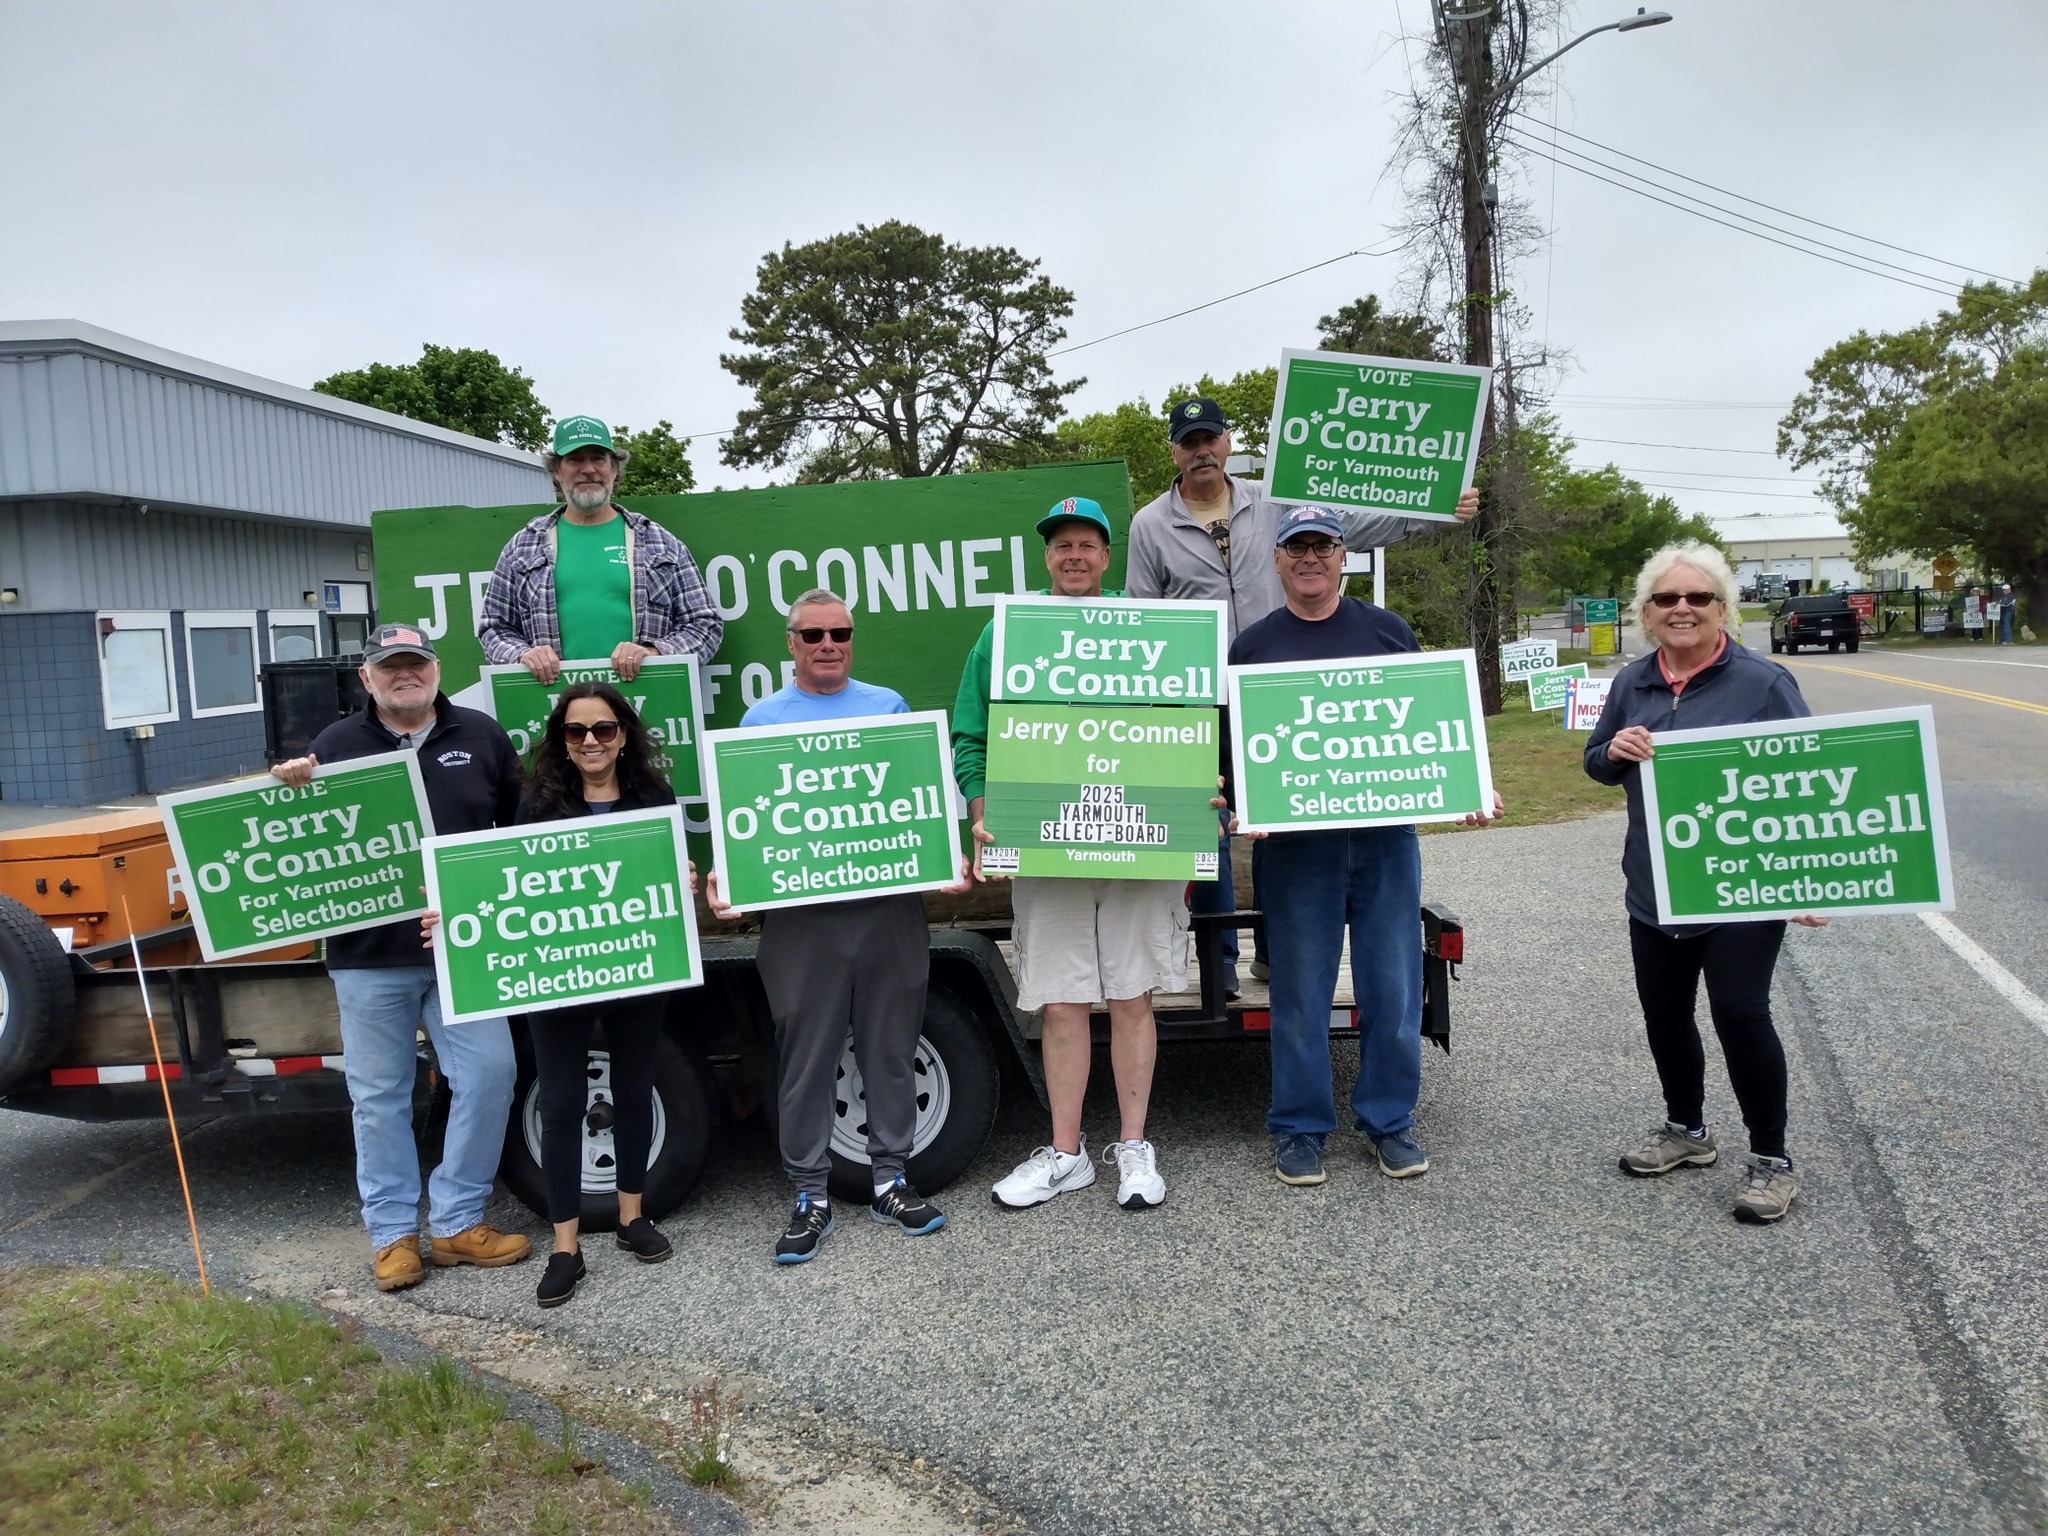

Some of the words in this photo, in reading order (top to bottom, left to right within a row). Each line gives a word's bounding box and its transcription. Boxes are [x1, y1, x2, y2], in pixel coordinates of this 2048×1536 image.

[1358, 368, 1412, 386] VOTE
[1328, 388, 1431, 432] Jerry
[1284, 410, 1465, 461] O'Connell
[1305, 454, 1337, 471] For
[1343, 458, 1439, 482] Yarmouth
[1062, 498, 1076, 514] B
[1307, 476, 1432, 506] Selectboard
[705, 535, 1041, 621] O'CONNEL
[1081, 610, 1142, 625] VOTE
[1054, 631, 1167, 670] Jerry
[1507, 657, 1554, 672] ARGO
[1526, 647, 1547, 658] LIZ
[1006, 656, 1212, 698] O'Connell
[1318, 669, 1383, 687] VOTE
[1294, 696, 1414, 730] Jerry
[797, 733, 861, 752] VOTE
[1000, 717, 1068, 744] Jerry
[1078, 719, 1211, 744] O'Connell
[1248, 720, 1470, 764] O'Connell
[1743, 734, 1820, 758] VOTE
[437, 751, 472, 763] BOSTON
[1086, 754, 1120, 773] for
[774, 761, 890, 797] Jerry
[1281, 771, 1320, 787] For
[1326, 762, 1447, 785] Yarmouth
[1717, 766, 1858, 806] Jerry
[259, 780, 328, 806] VOTE
[1082, 786, 1123, 803] 2025
[1290, 785, 1444, 816] Selectboard
[242, 804, 361, 848] Jerry
[728, 786, 942, 840] O'Connell
[1062, 804, 1144, 823] YARMOUTH
[1665, 794, 1926, 849] O'Connell
[521, 832, 590, 855] VOTE
[762, 846, 801, 864] For
[808, 830, 922, 858] Yarmouth
[1042, 823, 1166, 843] SELECT-BOARD
[198, 821, 422, 893] O'Connell
[1066, 849, 1136, 863] Yarmouth
[1196, 853, 1217, 862] 2025
[1705, 855, 1749, 875] For
[1757, 844, 1898, 871] Yarmouth
[239, 892, 279, 912] For
[285, 864, 404, 901] Yarmouth
[498, 860, 621, 900] Jerry
[772, 854, 919, 894] Selectboard
[1716, 870, 1894, 906] Selectboard
[253, 885, 404, 936] Selectboard
[449, 882, 678, 948] O'Connell
[486, 951, 528, 971] For
[534, 930, 656, 963] Yarmouth
[497, 953, 654, 1001] Selectboard
